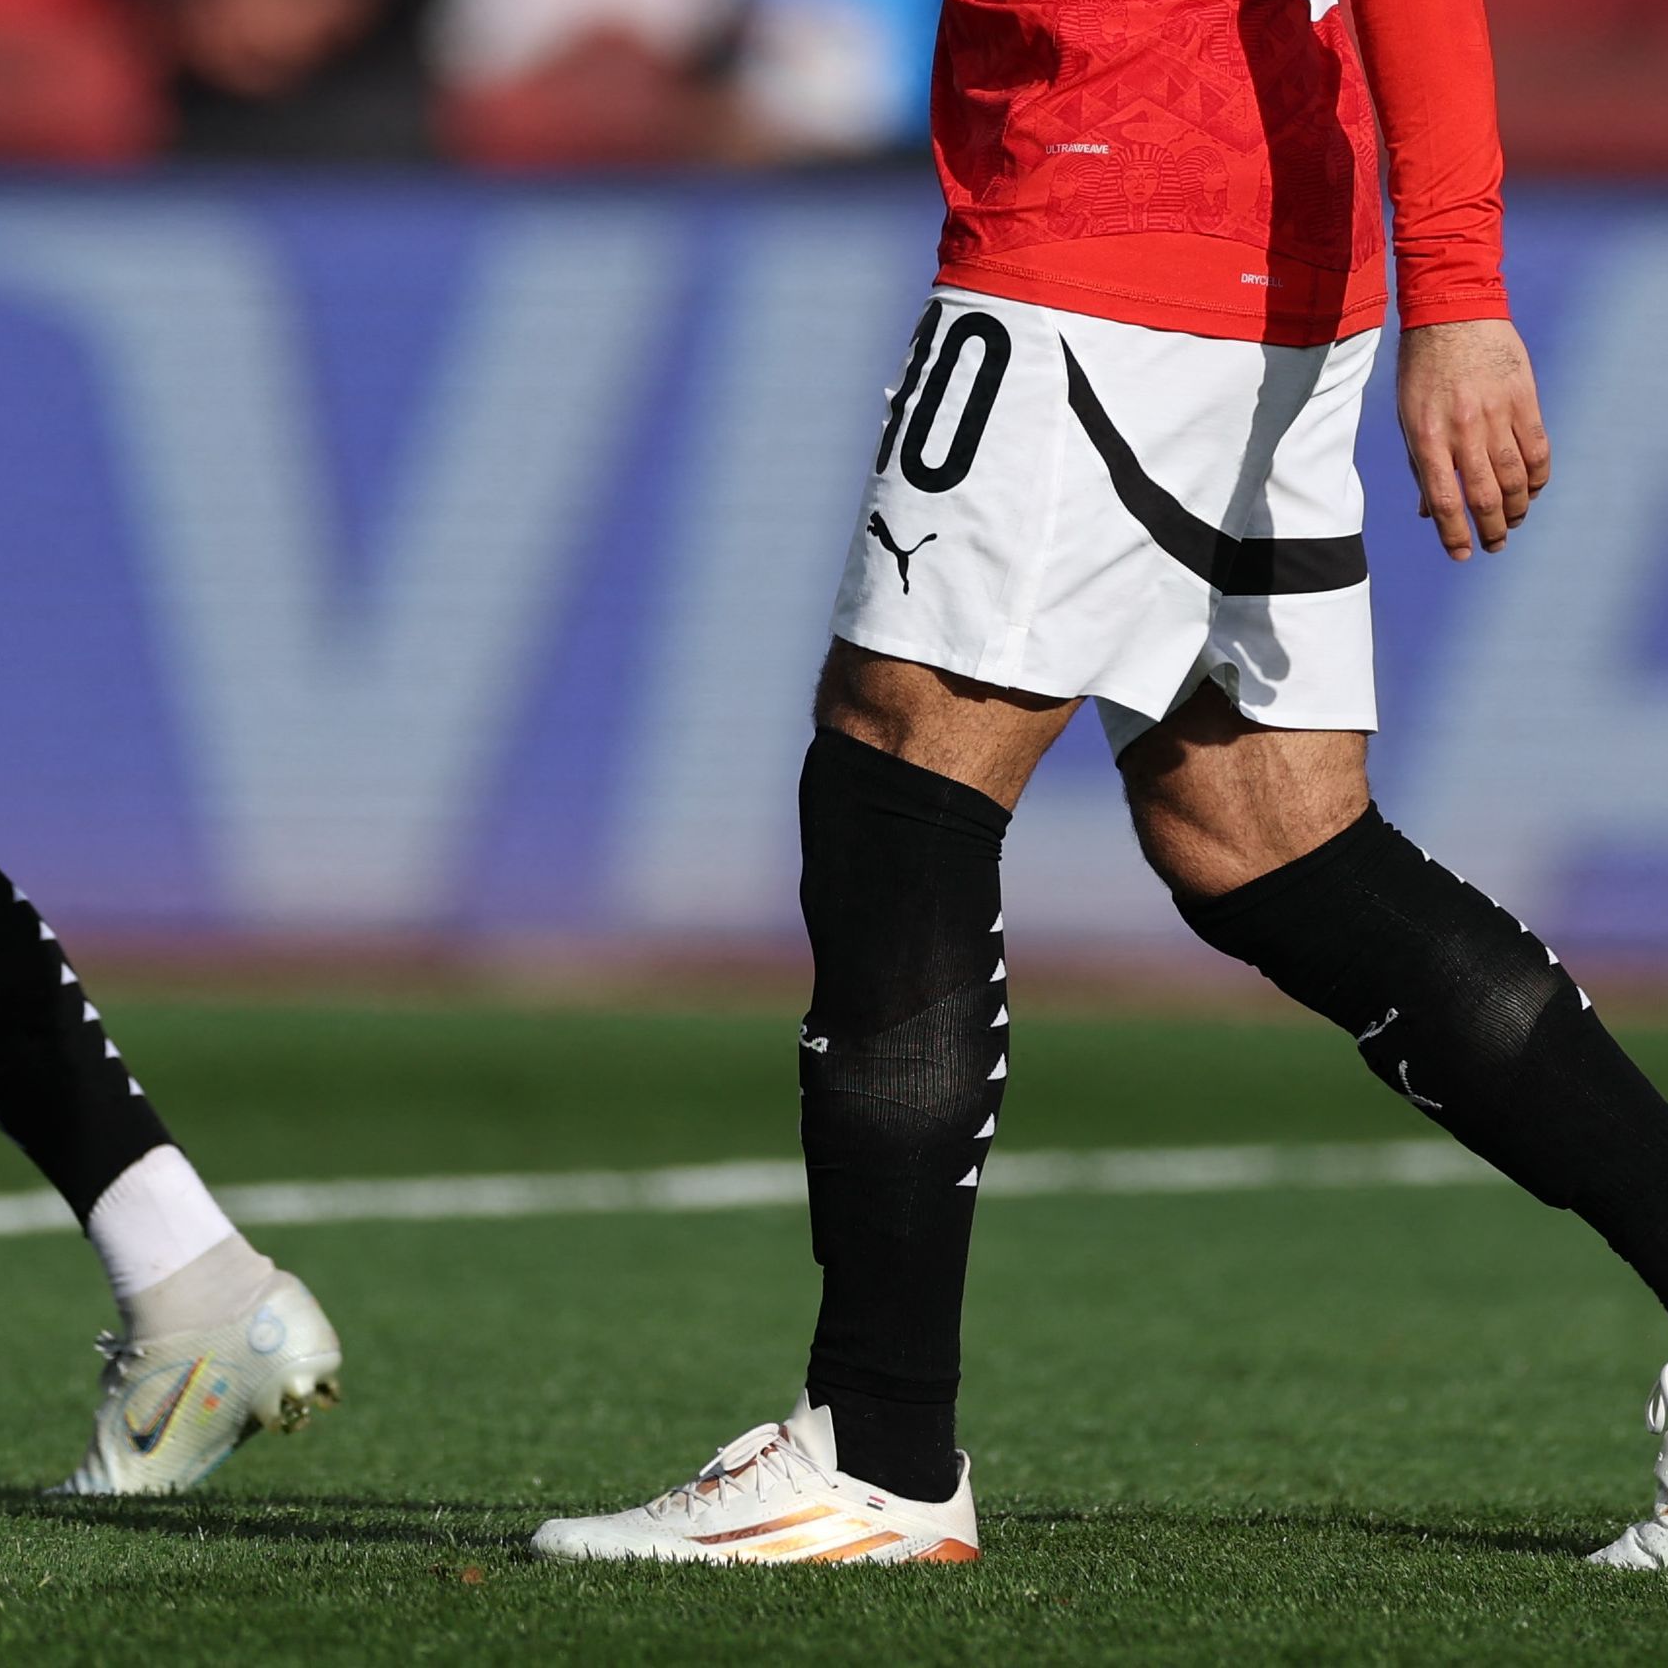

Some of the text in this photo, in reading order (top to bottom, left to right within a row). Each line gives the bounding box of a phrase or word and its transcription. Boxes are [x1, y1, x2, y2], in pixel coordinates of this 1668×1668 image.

[1045, 143, 1109, 155] ULTRAWEAVE
[1240, 272, 1284, 289] DRYCELL
[875, 299, 1012, 494] 10
